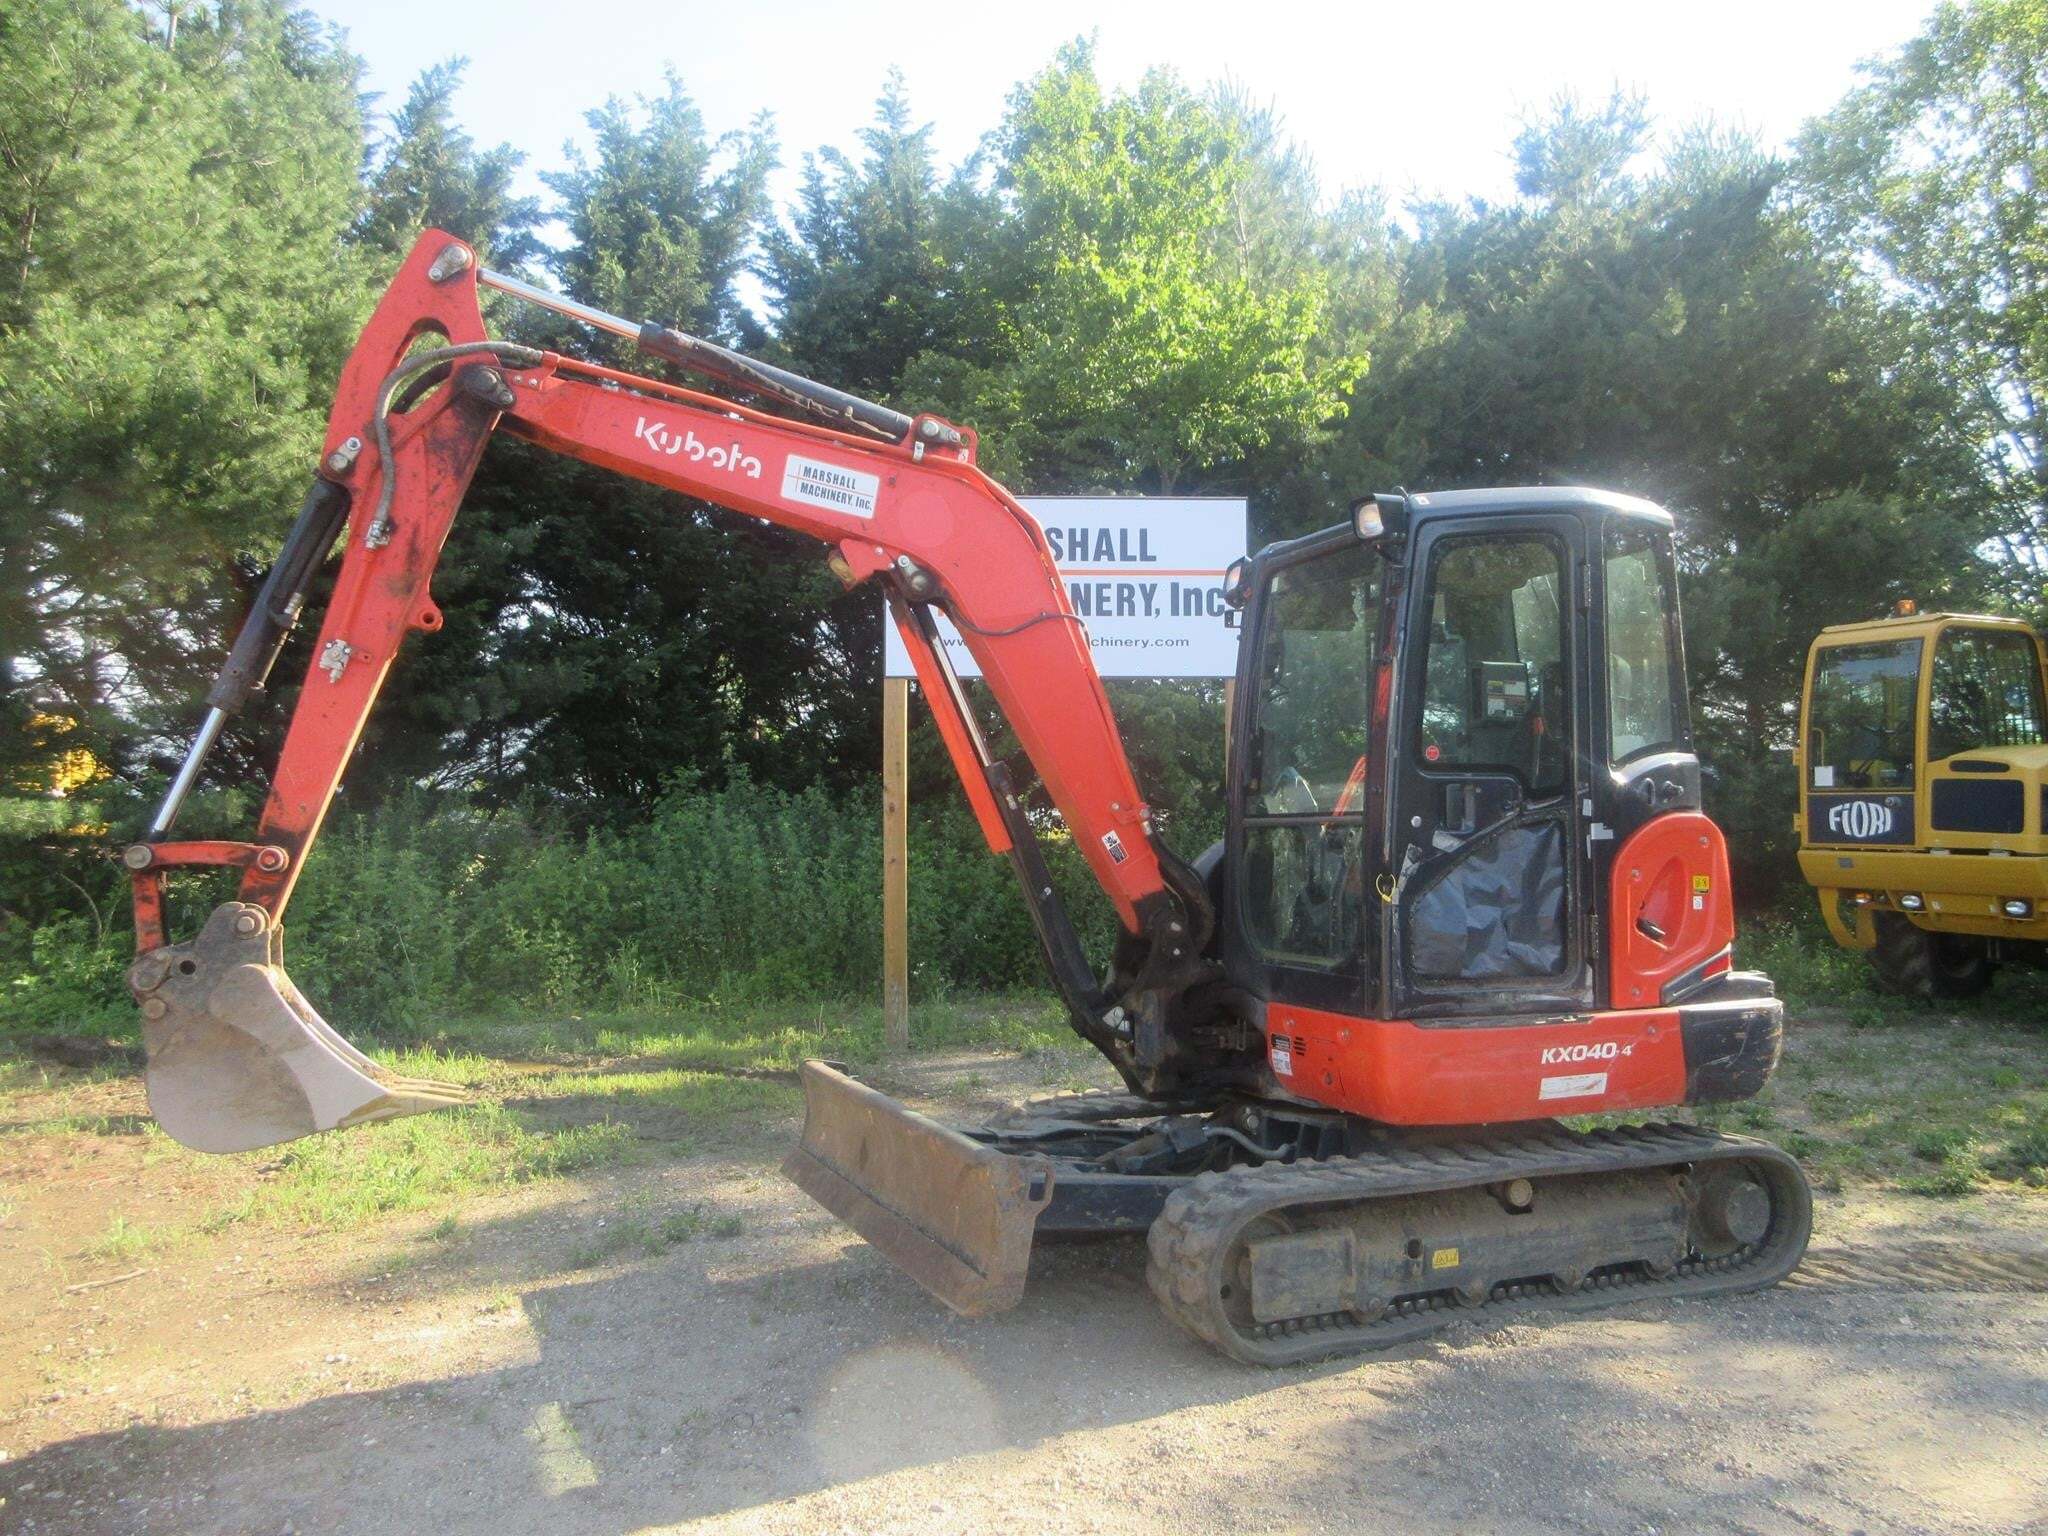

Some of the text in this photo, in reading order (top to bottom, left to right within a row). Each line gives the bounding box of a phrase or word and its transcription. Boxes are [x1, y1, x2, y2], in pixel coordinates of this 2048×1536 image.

[635, 416, 762, 478] Kubota
[803, 465, 856, 490] MARSHALL
[855, 496, 872, 511] Inc.
